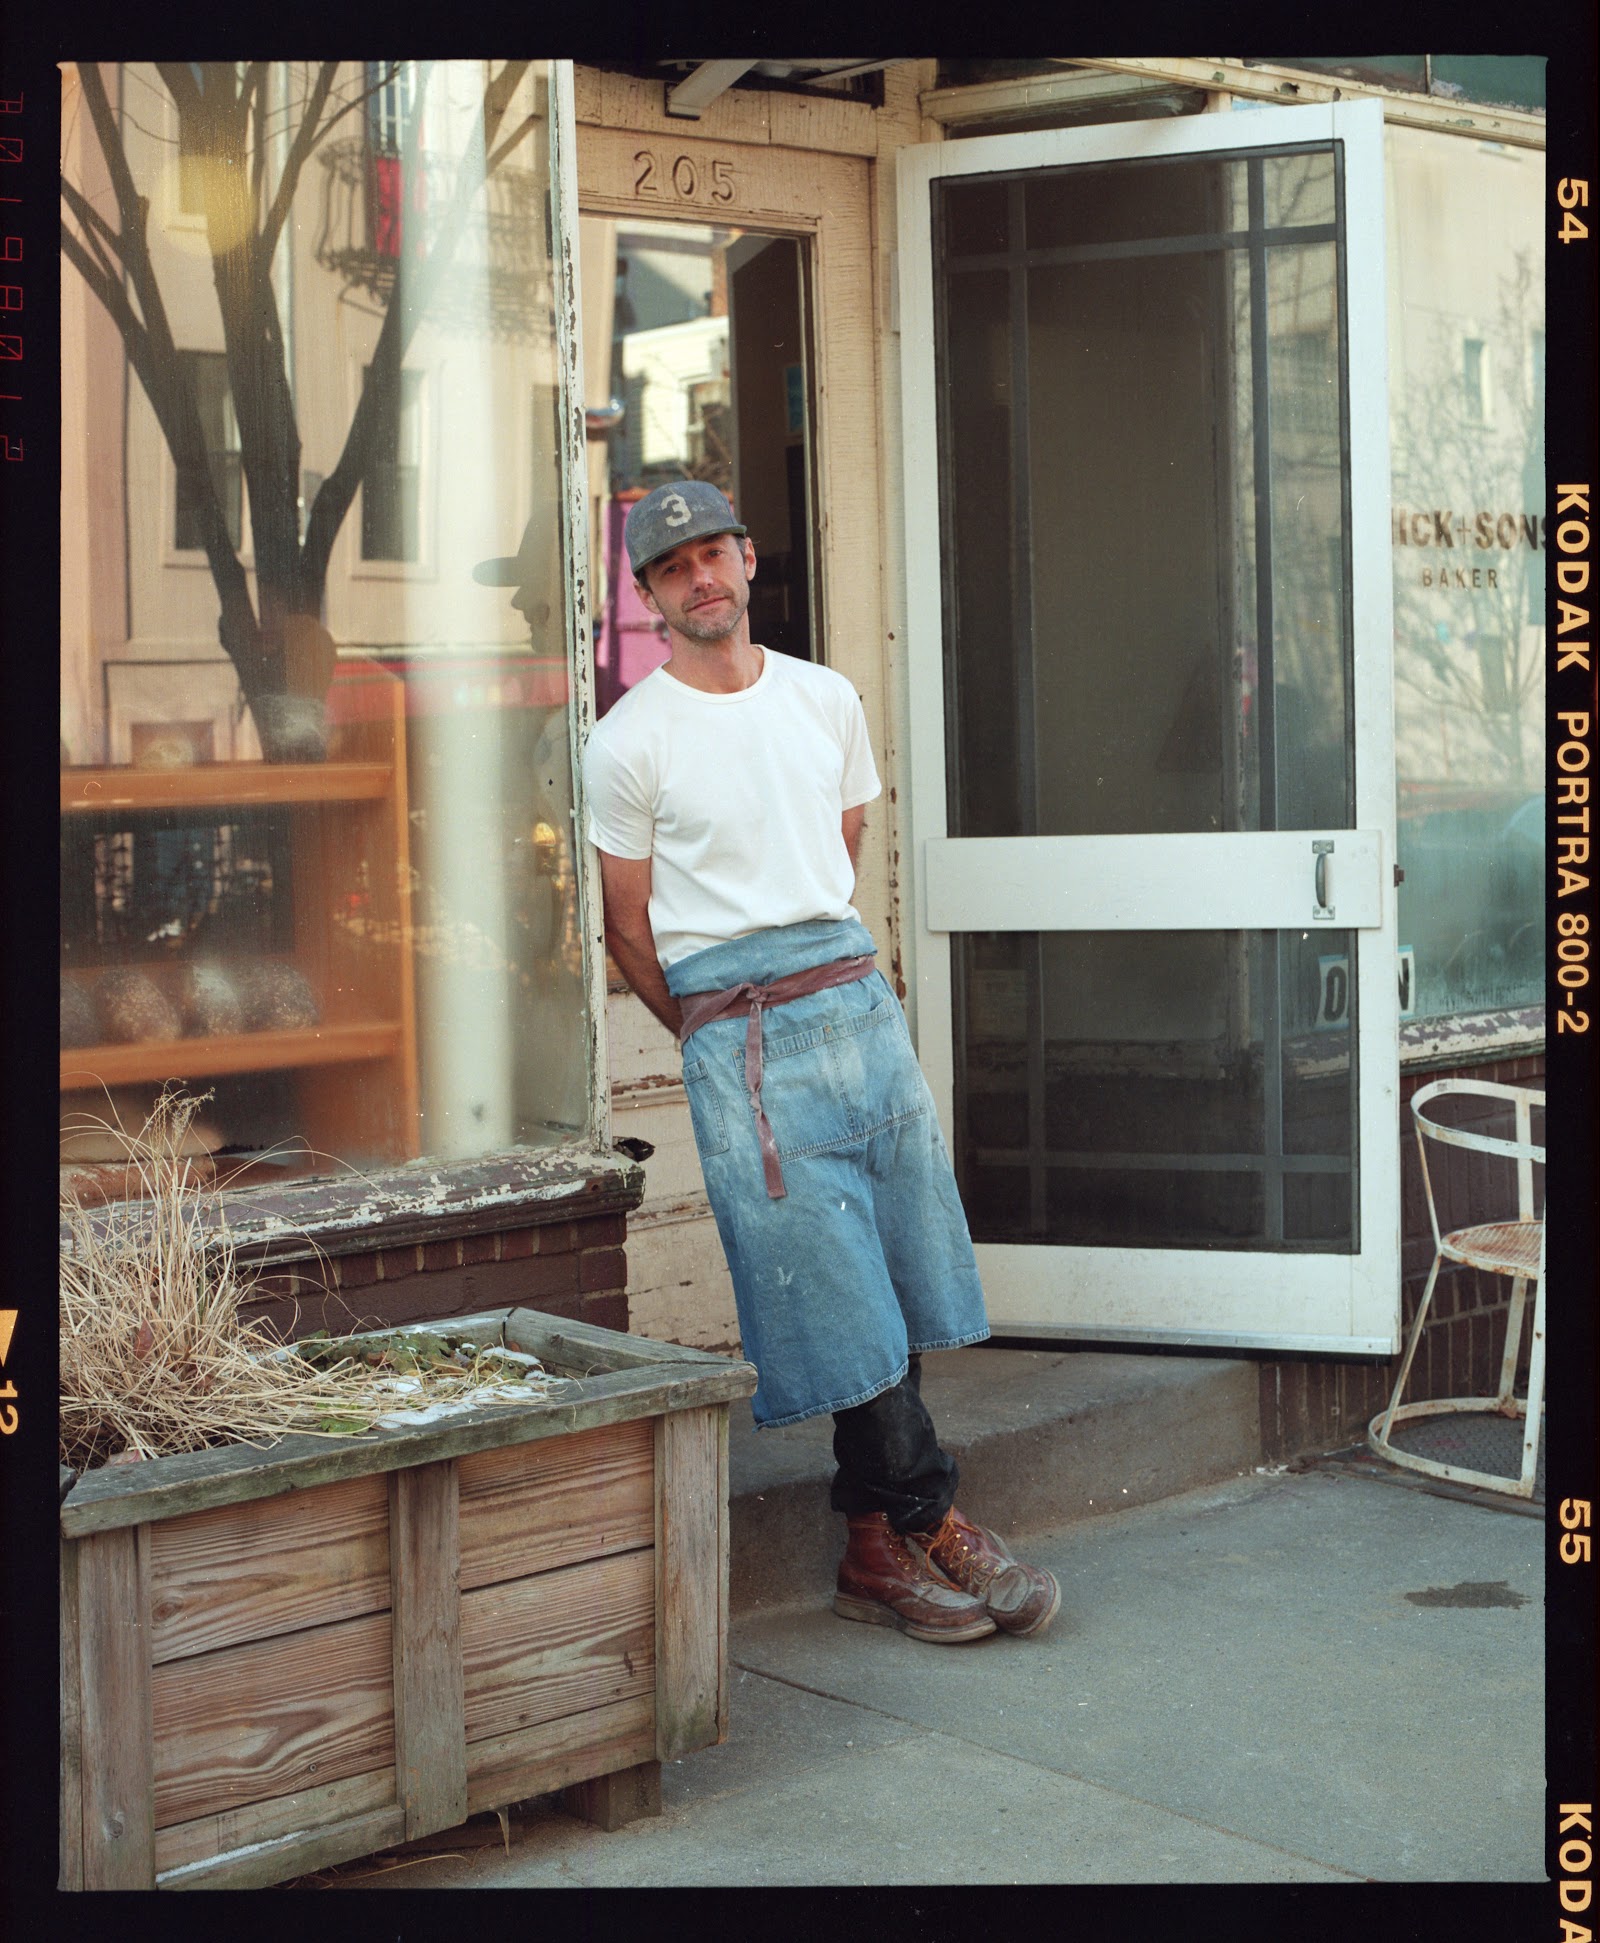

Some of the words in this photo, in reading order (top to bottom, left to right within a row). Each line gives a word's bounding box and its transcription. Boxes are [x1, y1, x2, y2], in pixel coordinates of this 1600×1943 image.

[633, 150, 737, 206] 205
[660, 493, 692, 528] 3
[1421, 567, 1499, 589] BAKER
